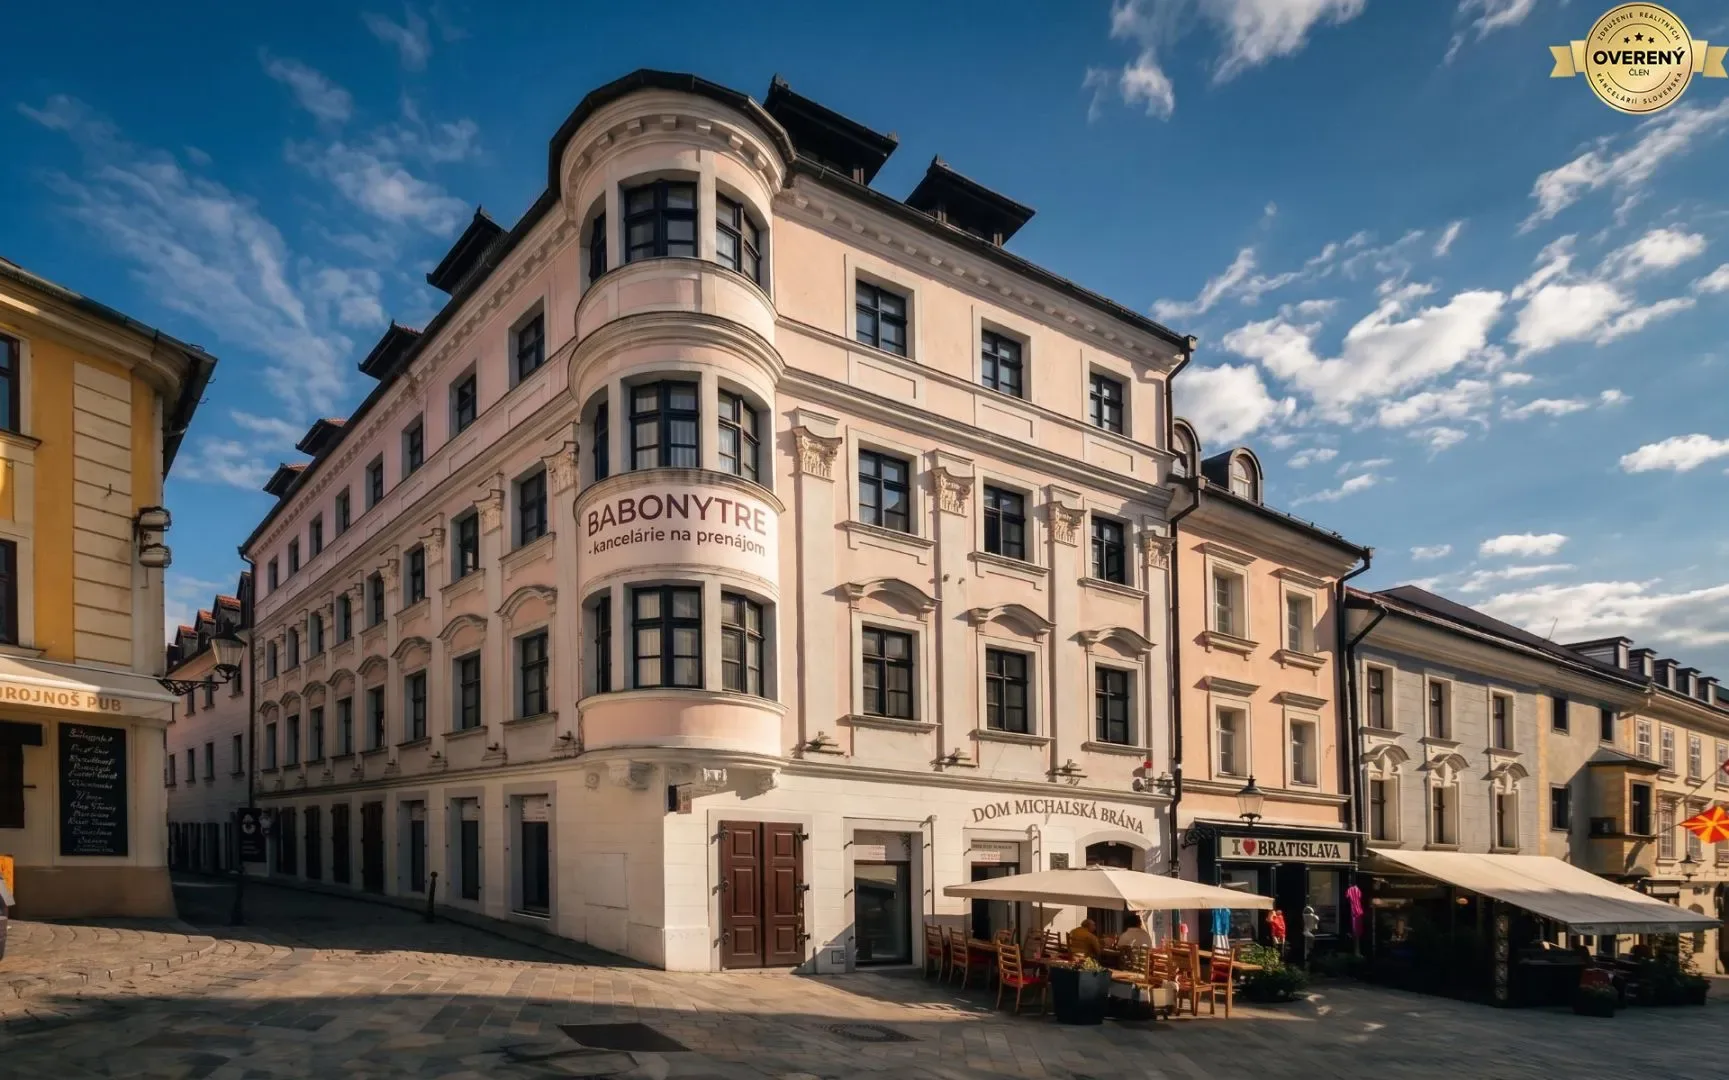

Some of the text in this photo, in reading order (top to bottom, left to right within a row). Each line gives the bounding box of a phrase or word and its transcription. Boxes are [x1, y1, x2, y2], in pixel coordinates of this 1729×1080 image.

[588, 493, 767, 537] BABONYTRE
[593, 527, 666, 555] kancelárie
[671, 529, 691, 541] na
[697, 529, 766, 557] prenájom
[0, 686, 122, 712] ROJNOŠ PUB
[972, 799, 1144, 834] DOM MICHALSKÁ BRÁNA
[1232, 839, 1341, 859] I BRATISLAVA
